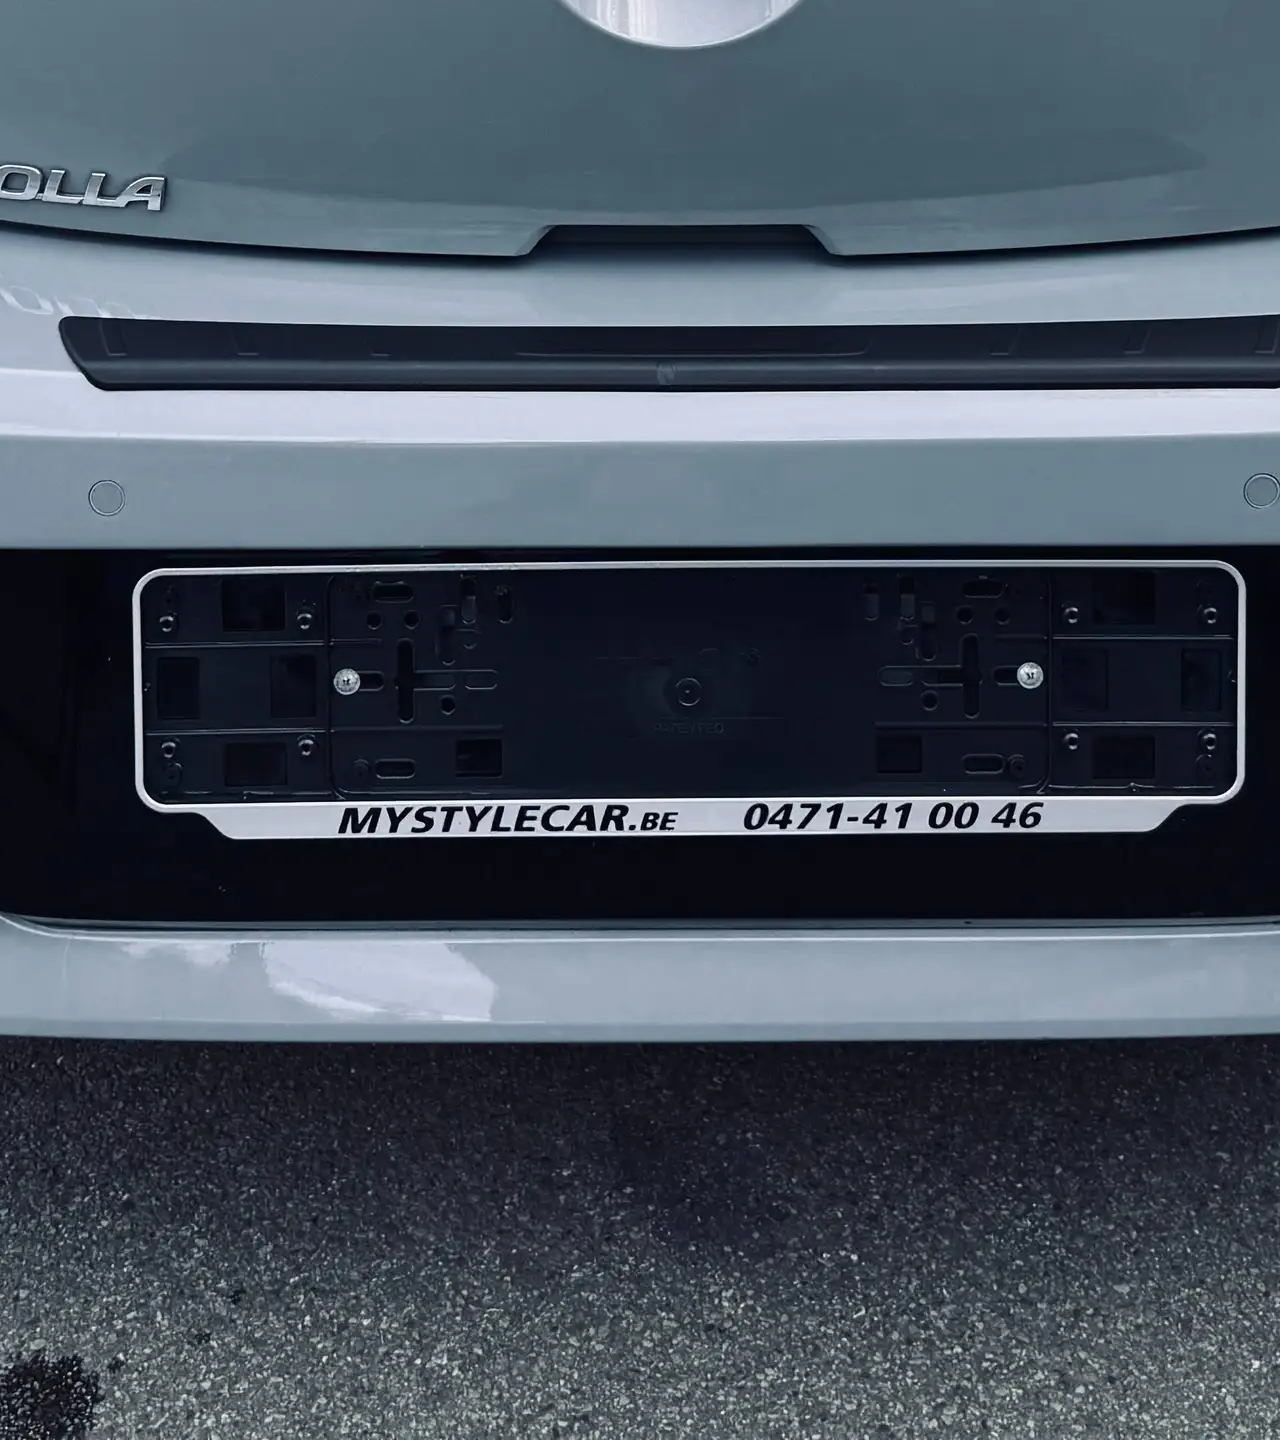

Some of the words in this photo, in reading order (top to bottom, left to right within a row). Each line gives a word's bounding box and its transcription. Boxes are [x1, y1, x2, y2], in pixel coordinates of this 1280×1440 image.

[337, 804, 678, 834] MYSTYLECAR.BE
[743, 802, 912, 830] 0471-41
[927, 802, 980, 829] 00
[991, 802, 1044, 828] 46
